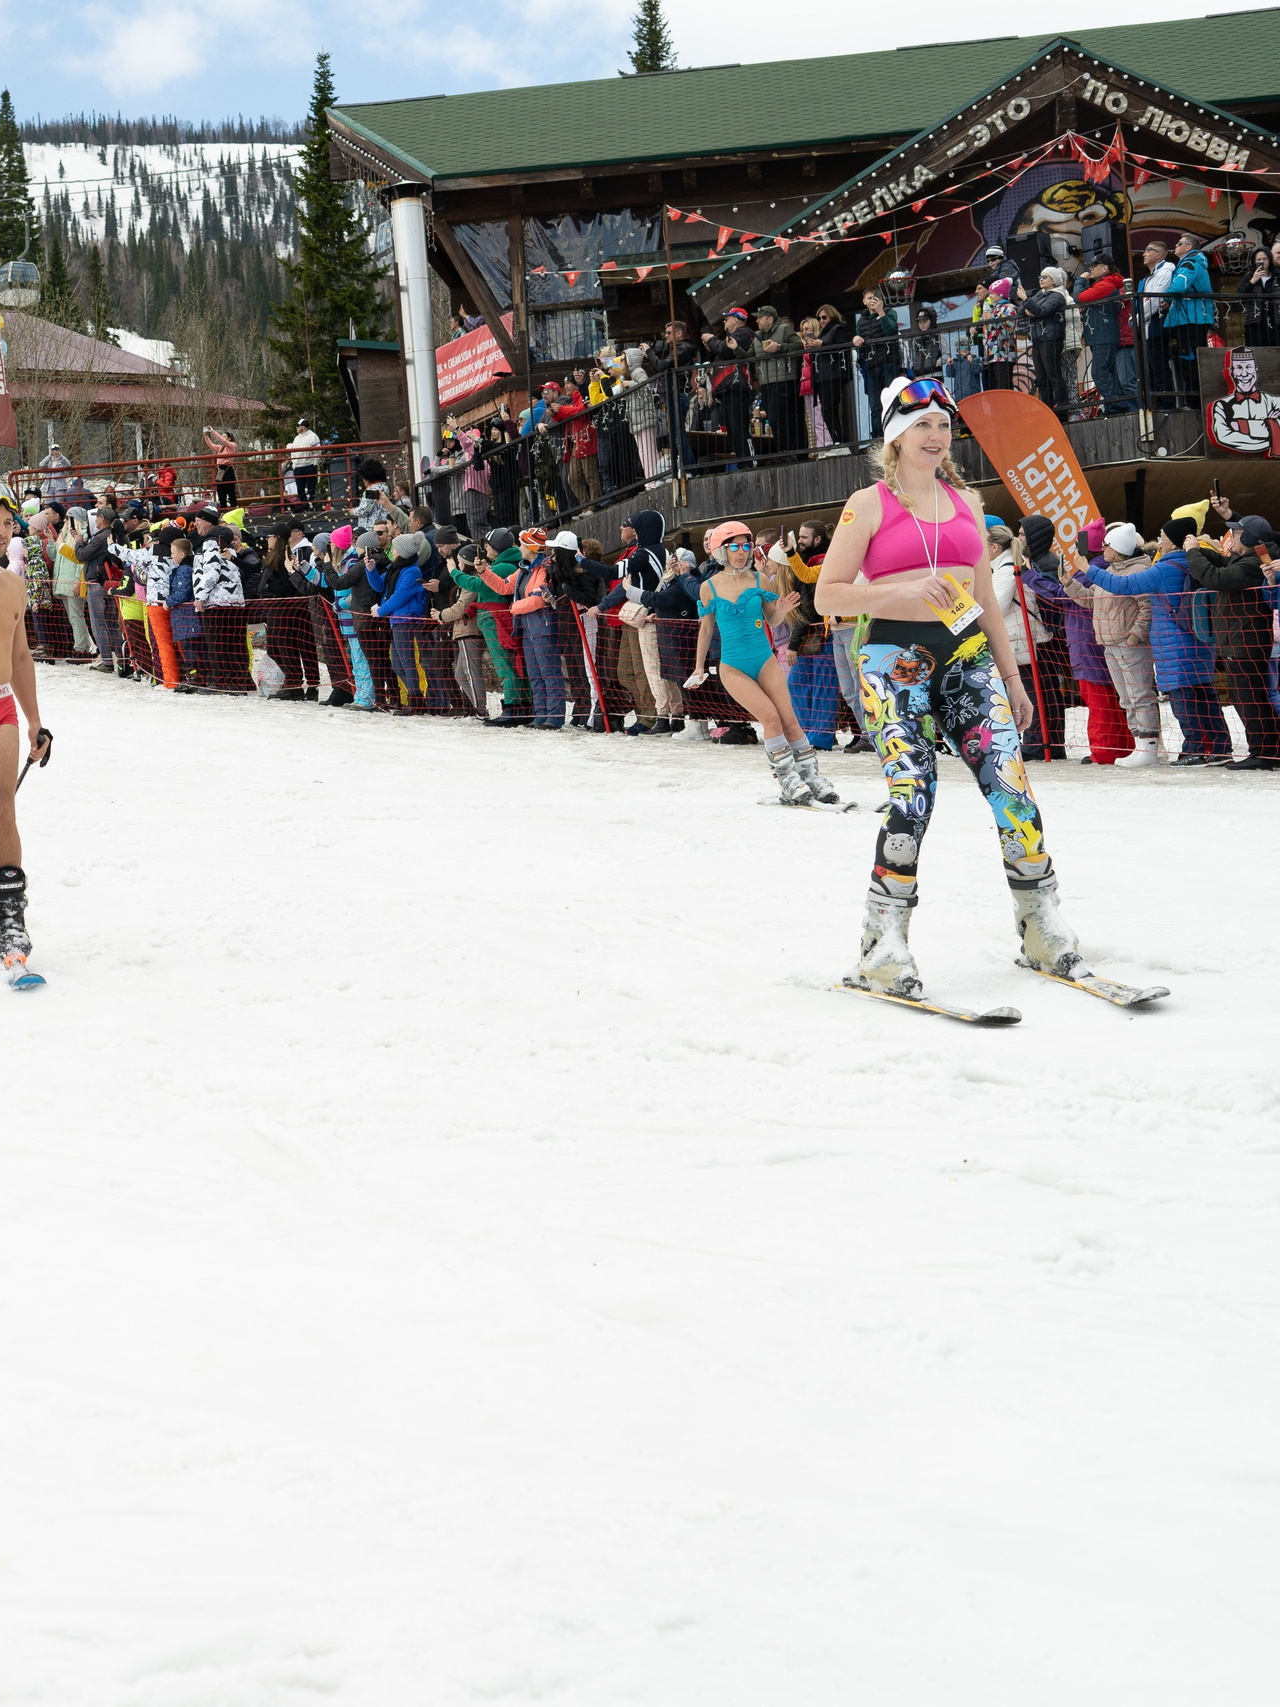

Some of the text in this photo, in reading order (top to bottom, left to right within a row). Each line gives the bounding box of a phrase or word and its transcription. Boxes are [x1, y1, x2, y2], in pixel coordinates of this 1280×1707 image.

[1082, 77, 1251, 171] ПО ЛЮБВИ
[817, 163, 937, 247] ГРЕЛКА
[950, 602, 965, 616] 140
